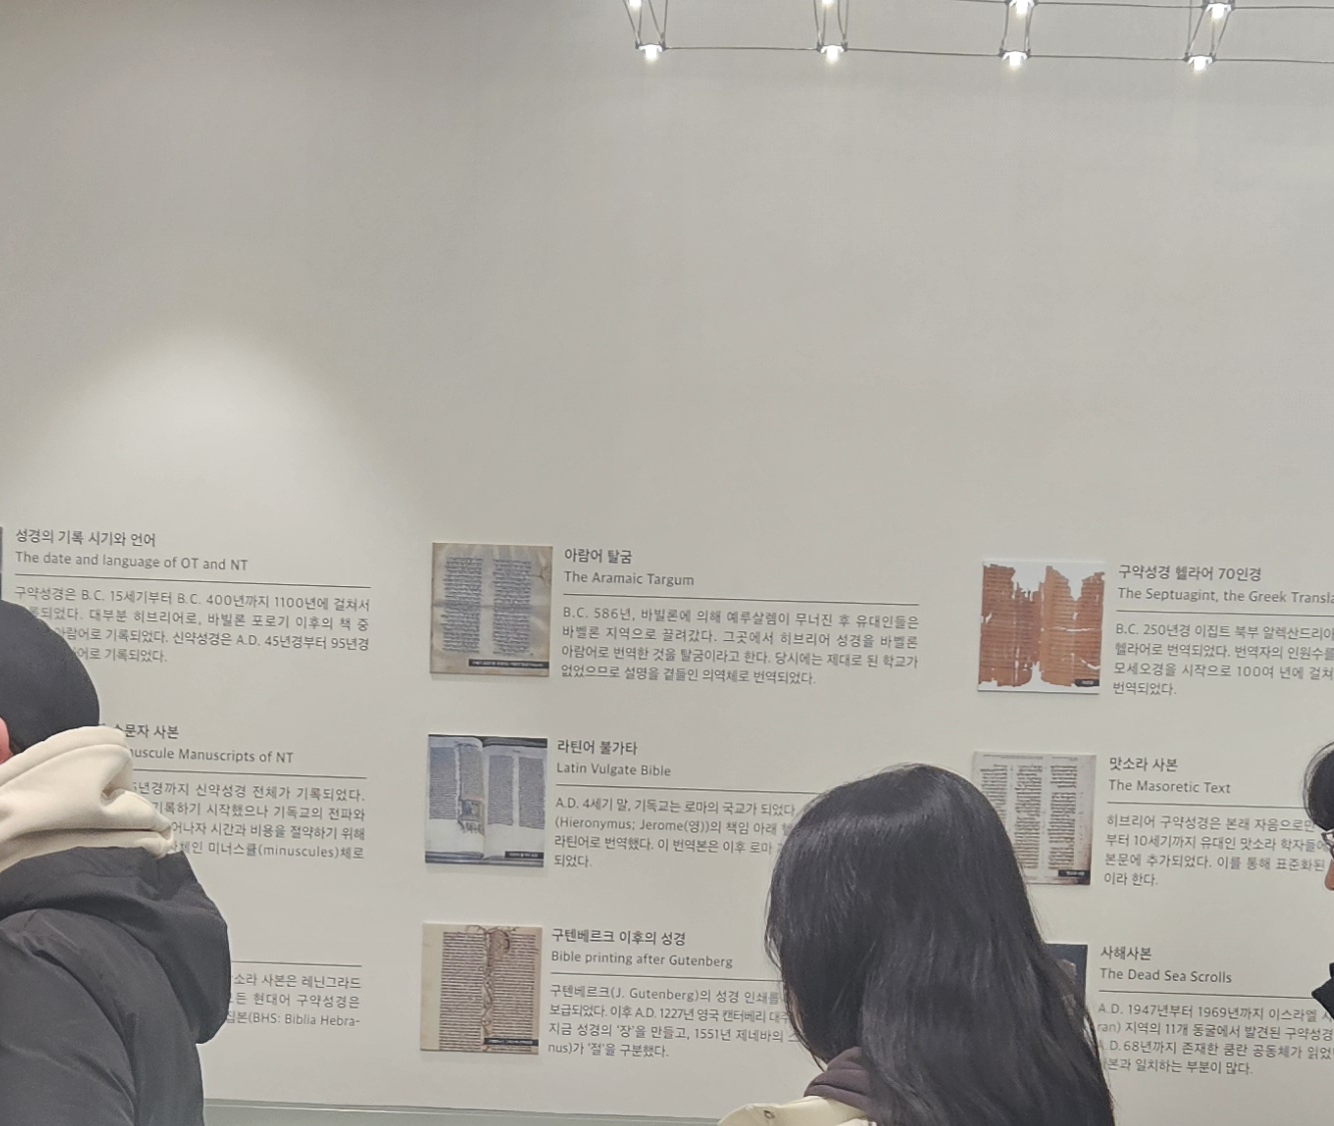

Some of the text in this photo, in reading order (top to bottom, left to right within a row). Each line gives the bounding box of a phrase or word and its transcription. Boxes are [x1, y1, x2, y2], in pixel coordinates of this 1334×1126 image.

[15, 528, 156, 548] 성경의 기록 시기와 언어
[15, 550, 248, 571] The date and language of OT and NT
[564, 548, 632, 564] 아람어 탈굼
[563, 570, 694, 588] The Aramaic Targum
[1118, 564, 1170, 580] 구약성경
[1218, 567, 1261, 582] 70인경
[14, 587, 76, 603] 구약성경은
[110, 590, 172, 605] 15세기부터
[206, 594, 269, 608] 400년까지
[275, 596, 329, 611] 1100년에
[334, 598, 370, 612] 걸쳐서
[1117, 587, 1142, 599] The
[1145, 587, 1219, 603] Septuagint,
[1224, 589, 1245, 602] the
[1248, 590, 1287, 603] Greek
[89, 609, 128, 623] 대부분
[208, 612, 246, 627] 바빌론
[251, 615, 289, 629] 포로기
[295, 616, 333, 631] 이후의
[339, 617, 351, 631] 책
[357, 618, 369, 632] 중
[641, 608, 691, 623] 바빌론에
[696, 610, 722, 624] 의해
[727, 611, 790, 626] 예루살렘이
[795, 612, 833, 627] 무너진
[838, 614, 850, 628] 후
[856, 614, 919, 630] 유대인들은
[562, 625, 600, 640] 바벨론
[606, 624, 657, 641] 지역으로
[723, 630, 774, 645] 그곳에서
[780, 632, 830, 647] 히브리어
[836, 634, 875, 648] 성경을
[880, 635, 918, 650] 바벨론
[1143, 623, 1191, 638] 250년경
[1195, 624, 1231, 638] 이집트
[1234, 645, 1283, 660] 번역자의
[153, 725, 179, 740] 사본
[178, 748, 255, 764] Manuscripts
[259, 751, 273, 763] of
[276, 752, 294, 764] NT
[557, 739, 638, 756] 라틴어 불가타
[556, 762, 671, 777] Latin Vulgate Bible
[1110, 756, 1178, 773] 맛소라 사본
[195, 783, 246, 798] 신약성경
[252, 785, 290, 800] 전체가
[1108, 778, 1231, 794] The Masoretic Text
[582, 797, 613, 812] 4세기
[634, 799, 681, 814] 기독교는
[684, 800, 719, 815] 로마의
[722, 801, 757, 816] 국교가
[1105, 853, 1142, 867] 본문에
[1217, 856, 1241, 870] 이를
[1246, 857, 1271, 871] 통해
[1275, 858, 1325, 872] 표준화된
[551, 928, 685, 946] 구텐베르크 이후의 성경
[551, 950, 733, 969] Bible printing after Gutenberg
[1100, 945, 1152, 961] 사해사본
[261, 974, 362, 990] 사본은 레닌그라드
[1100, 967, 1232, 983] The Dead Sea Scrolls
[253, 992, 360, 1009] 현대어 구약성경은
[629, 987, 711, 1003] Gutenberg)의
[716, 990, 739, 1004] 성경
[1128, 1004, 1193, 1018] 1947년부터
[1198, 1006, 1264, 1021] 1969년까지
[549, 1022, 572, 1036] 지금
[577, 1023, 612, 1037] 성경의
[651, 1026, 690, 1040] 만들고,
[695, 1028, 731, 1041] 1551년
[735, 1029, 783, 1043] 제네바의
[1125, 1021, 1281, 1040] 지역의 11개 동굴에서 발견된
